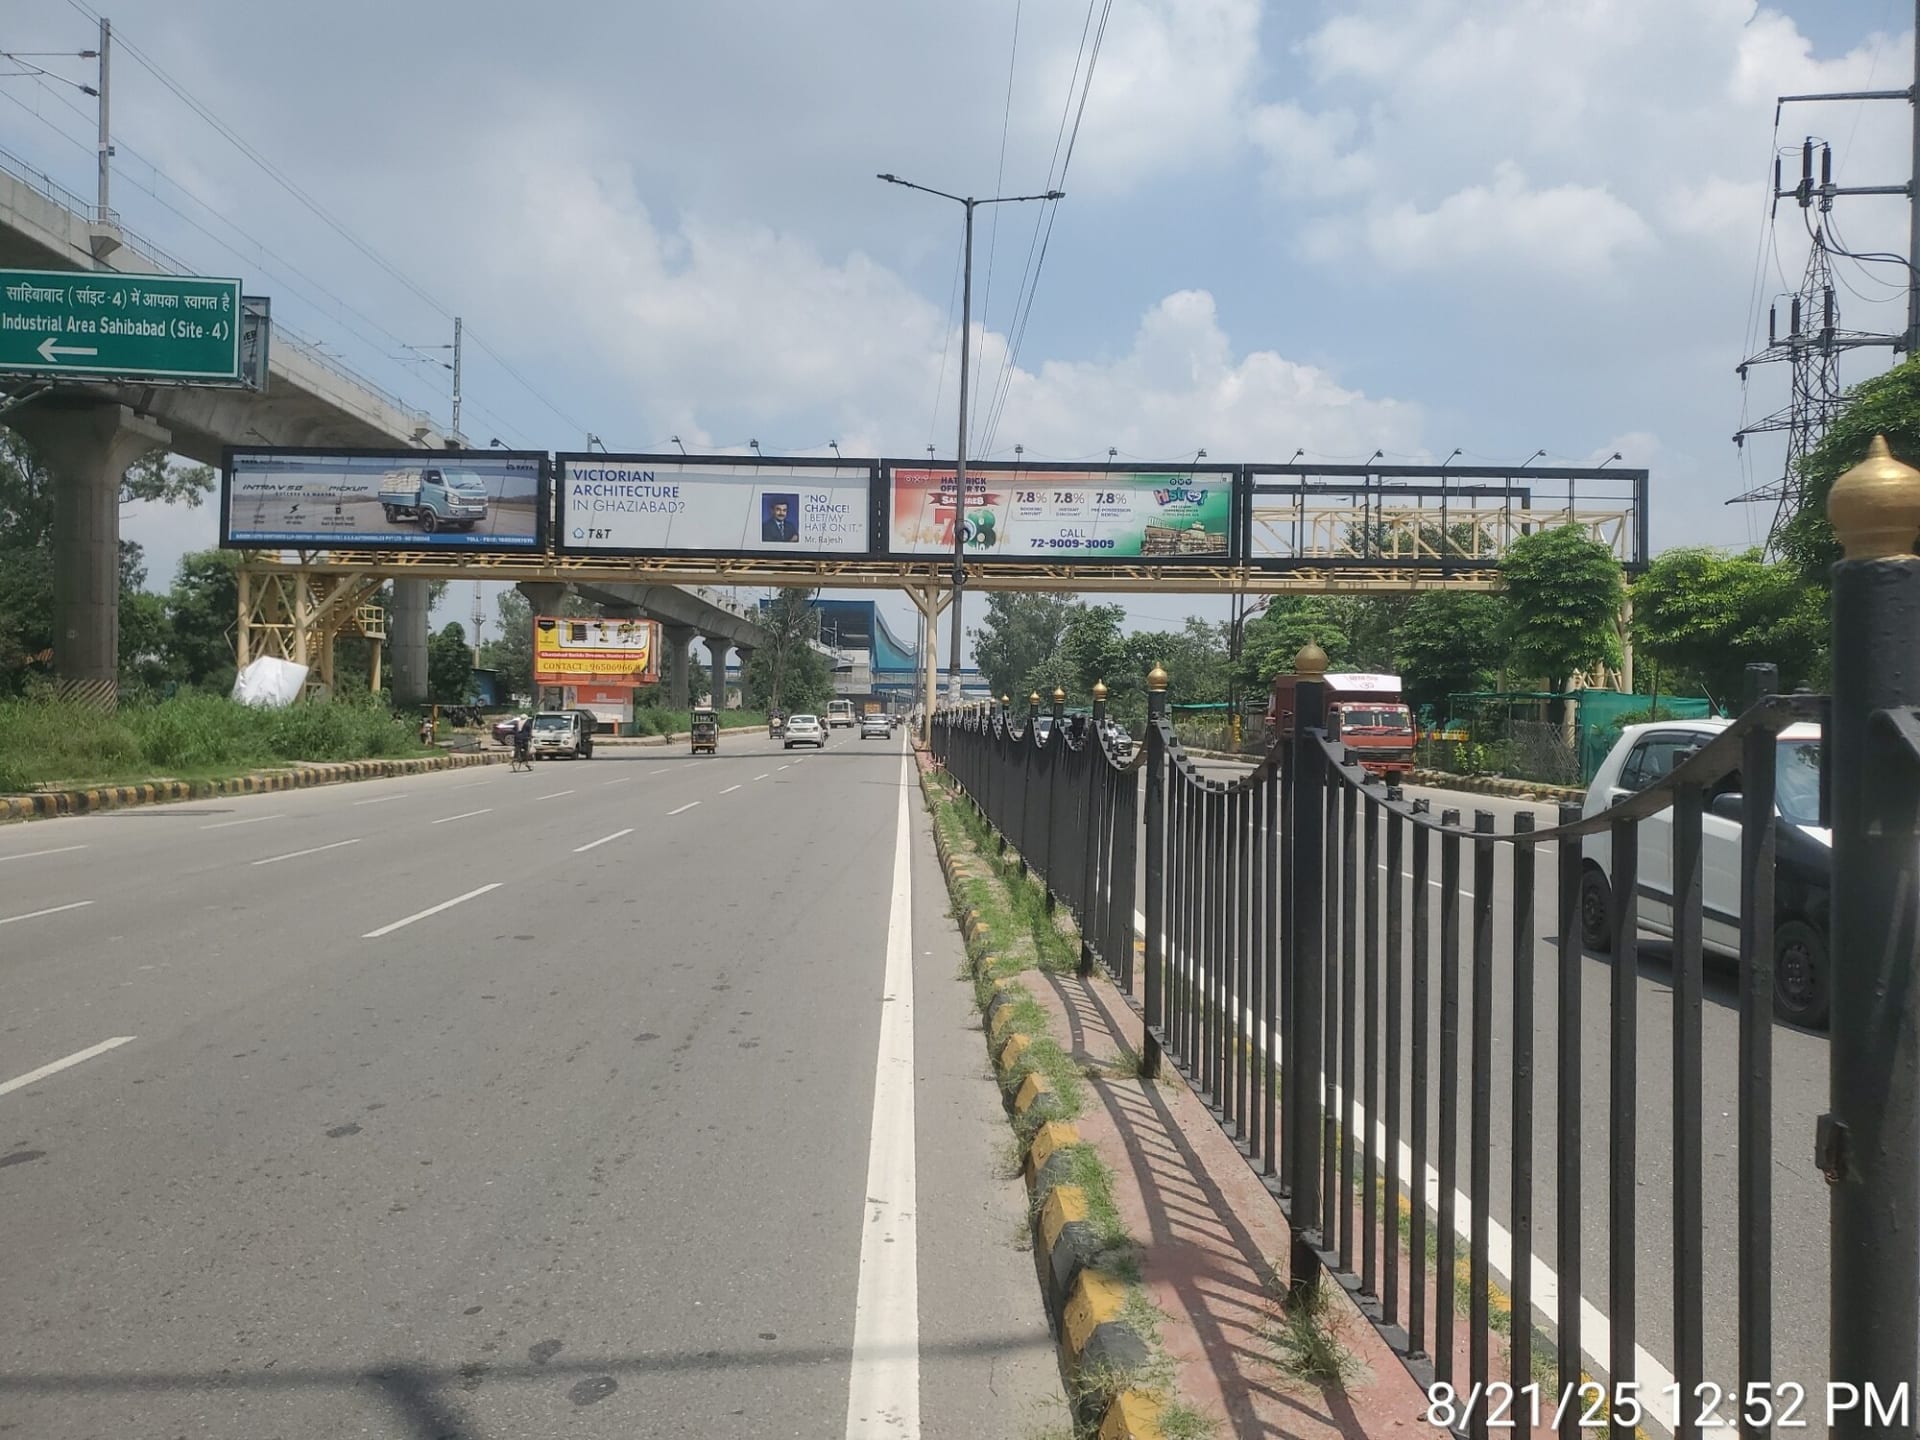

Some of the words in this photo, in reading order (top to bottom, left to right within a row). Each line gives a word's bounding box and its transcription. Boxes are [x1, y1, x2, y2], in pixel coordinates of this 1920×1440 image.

[6, 282, 64, 304] साहिबाबाद
[130, 287, 141, 306] में
[143, 293, 178, 308] आपका
[184, 295, 218, 310] स्वागत
[221, 291, 230, 312] है
[2, 312, 63, 332] Industrial
[66, 315, 96, 333] Area
[100, 316, 166, 338] Sahibabad
[573, 469, 655, 482] VICTORIAN
[573, 484, 680, 498] ARCHITECTURE
[1016, 492, 1047, 503] 7.8%
[1054, 492, 1085, 504] 7.8%
[1096, 493, 1127, 504] 7.8%
[573, 499, 588, 511] IN
[593, 499, 685, 514] GHAZIABAD?
[829, 513, 844, 522] MY
[805, 523, 827, 531] HAIR
[830, 523, 847, 532] ON
[588, 529, 612, 539] T&T
[1060, 529, 1086, 538] CALL
[1030, 538, 1115, 549] 72-9009-3009
[543, 663, 582, 671] CONTACT
